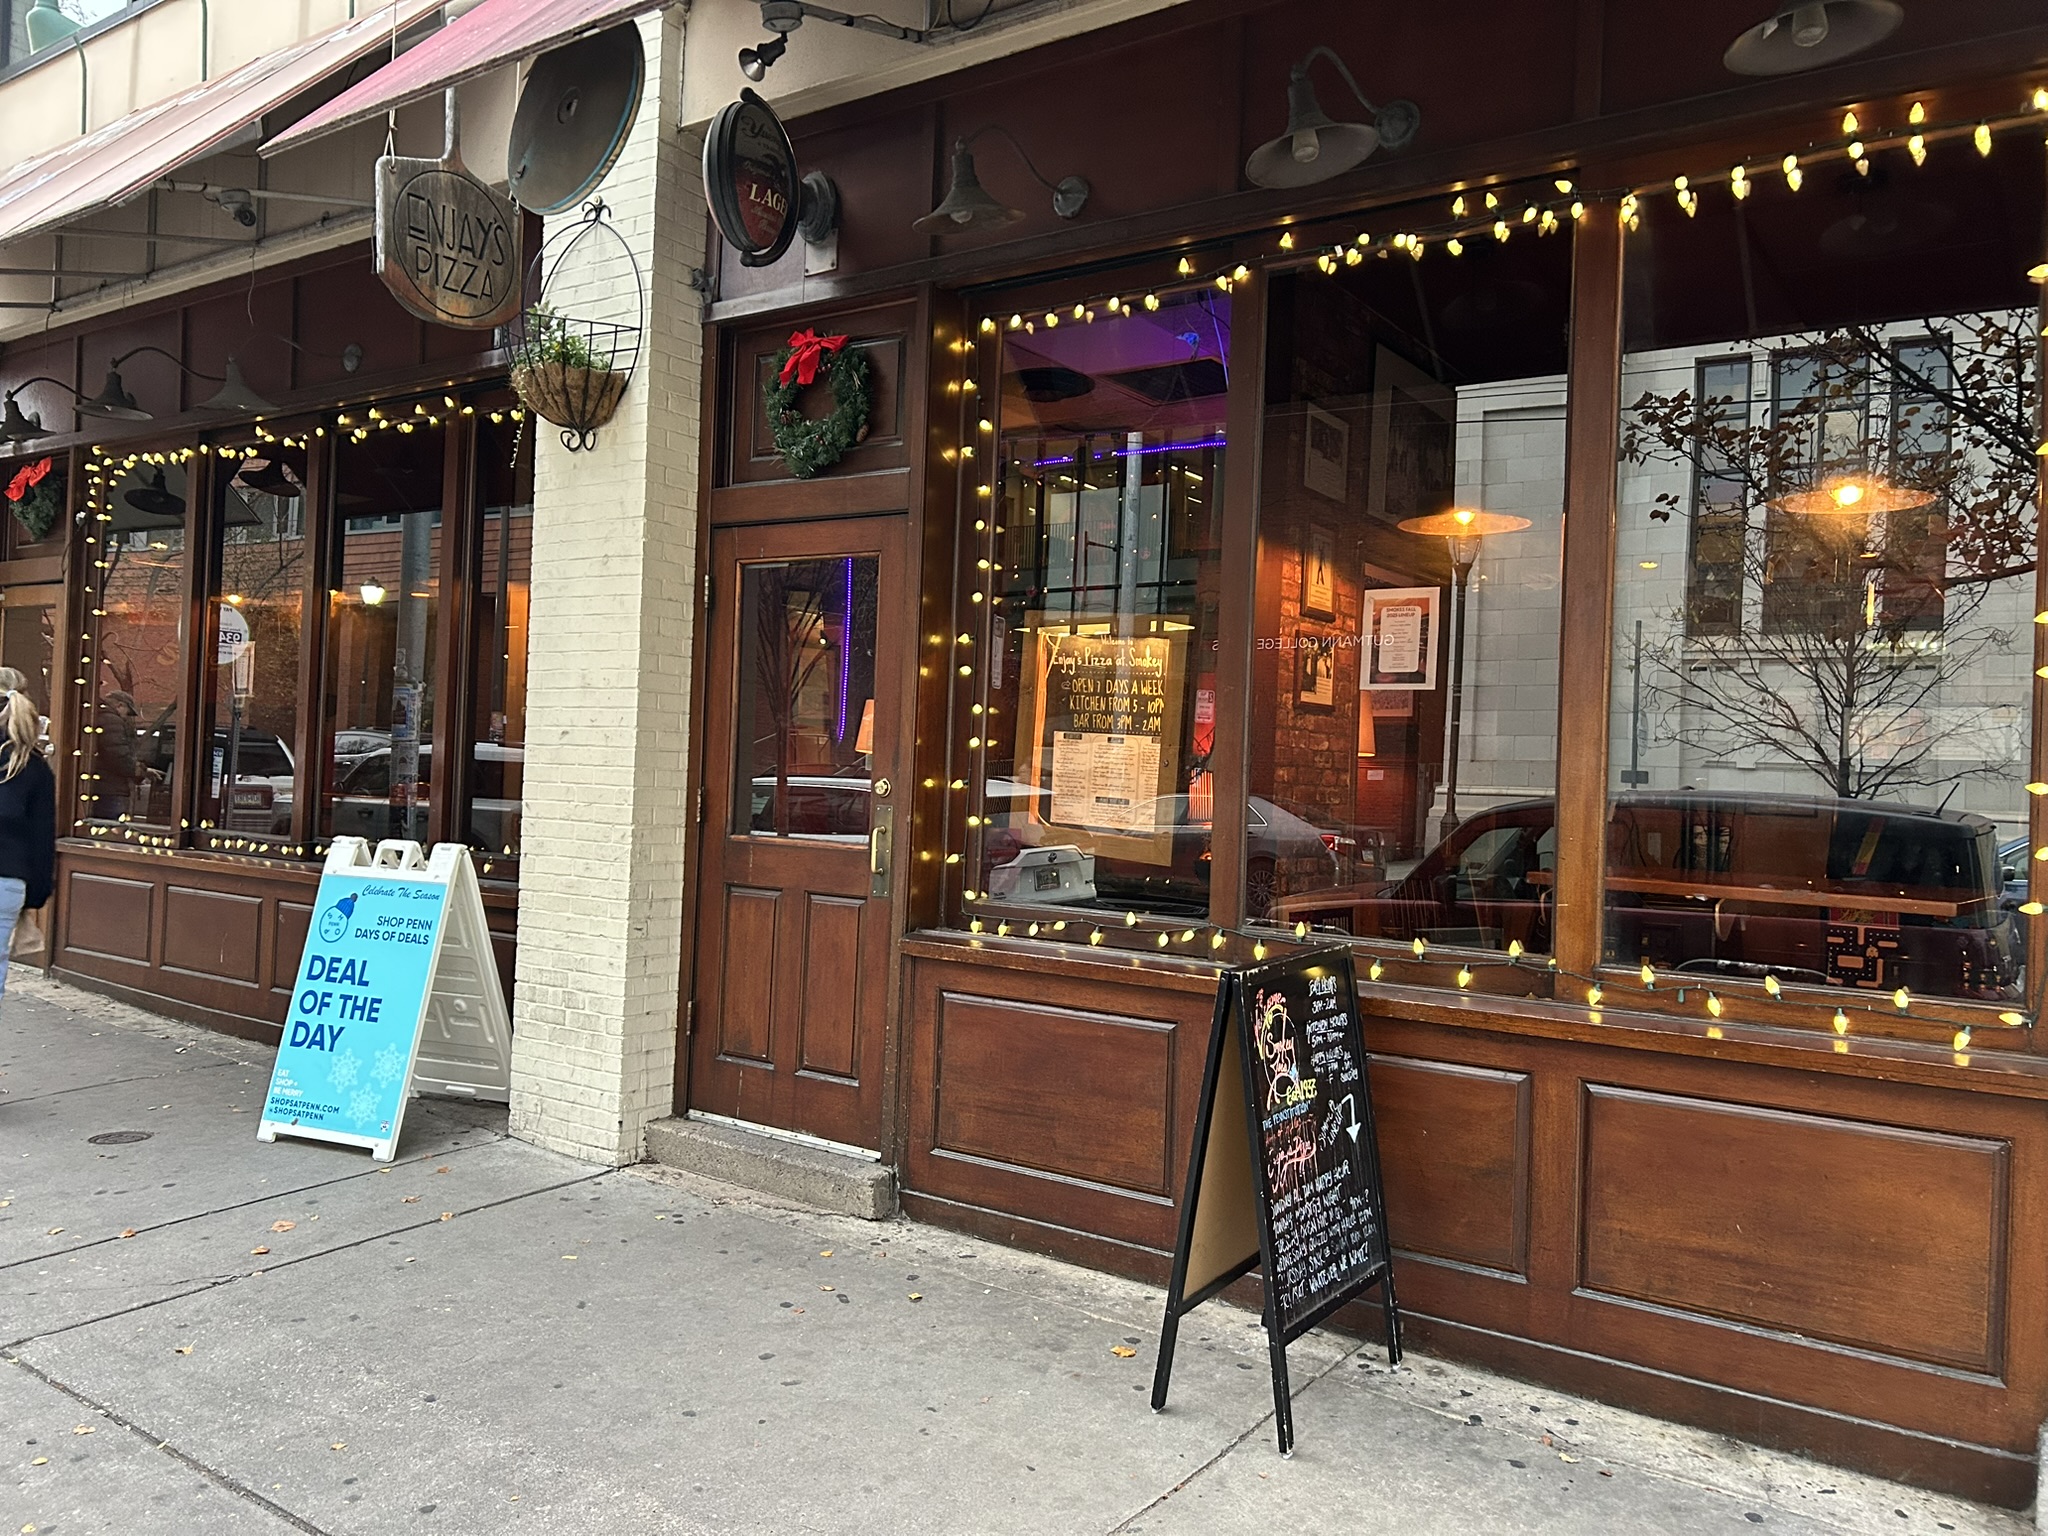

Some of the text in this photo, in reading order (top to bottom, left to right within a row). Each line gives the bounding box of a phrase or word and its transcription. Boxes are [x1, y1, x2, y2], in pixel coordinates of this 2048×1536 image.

[406, 192, 505, 267] ENJAY'S
[416, 245, 495, 303] PIZZA
[1100, 635, 1134, 646] Welcome to
[1084, 646, 1113, 667] Pizza
[1128, 644, 1163, 678] Smokey
[1072, 678, 1094, 693] OPEN
[1105, 679, 1129, 695] DAYS
[1130, 680, 1138, 695] A
[1140, 679, 1164, 696] WEEK
[1069, 695, 1107, 712] KITCHEN
[1108, 696, 1131, 713] FROM
[1132, 698, 1138, 713] 5
[1073, 713, 1090, 728] BAR
[1092, 714, 1114, 730] FROM
[1116, 715, 1132, 730] 3PM
[1142, 716, 1161, 732] 2AM
[362, 884, 441, 901] Celebrate The Season
[377, 915, 433, 931] SHOP PENN
[354, 928, 430, 946] DAYS OF DEALS
[306, 954, 370, 987] DEAL
[298, 989, 383, 1024] OF THE
[289, 1020, 346, 1053] DAY
[277, 1068, 290, 1077] EAT
[275, 1077, 294, 1087] SHOP
[270, 1096, 340, 1114] SHOPSATPENN.COM
